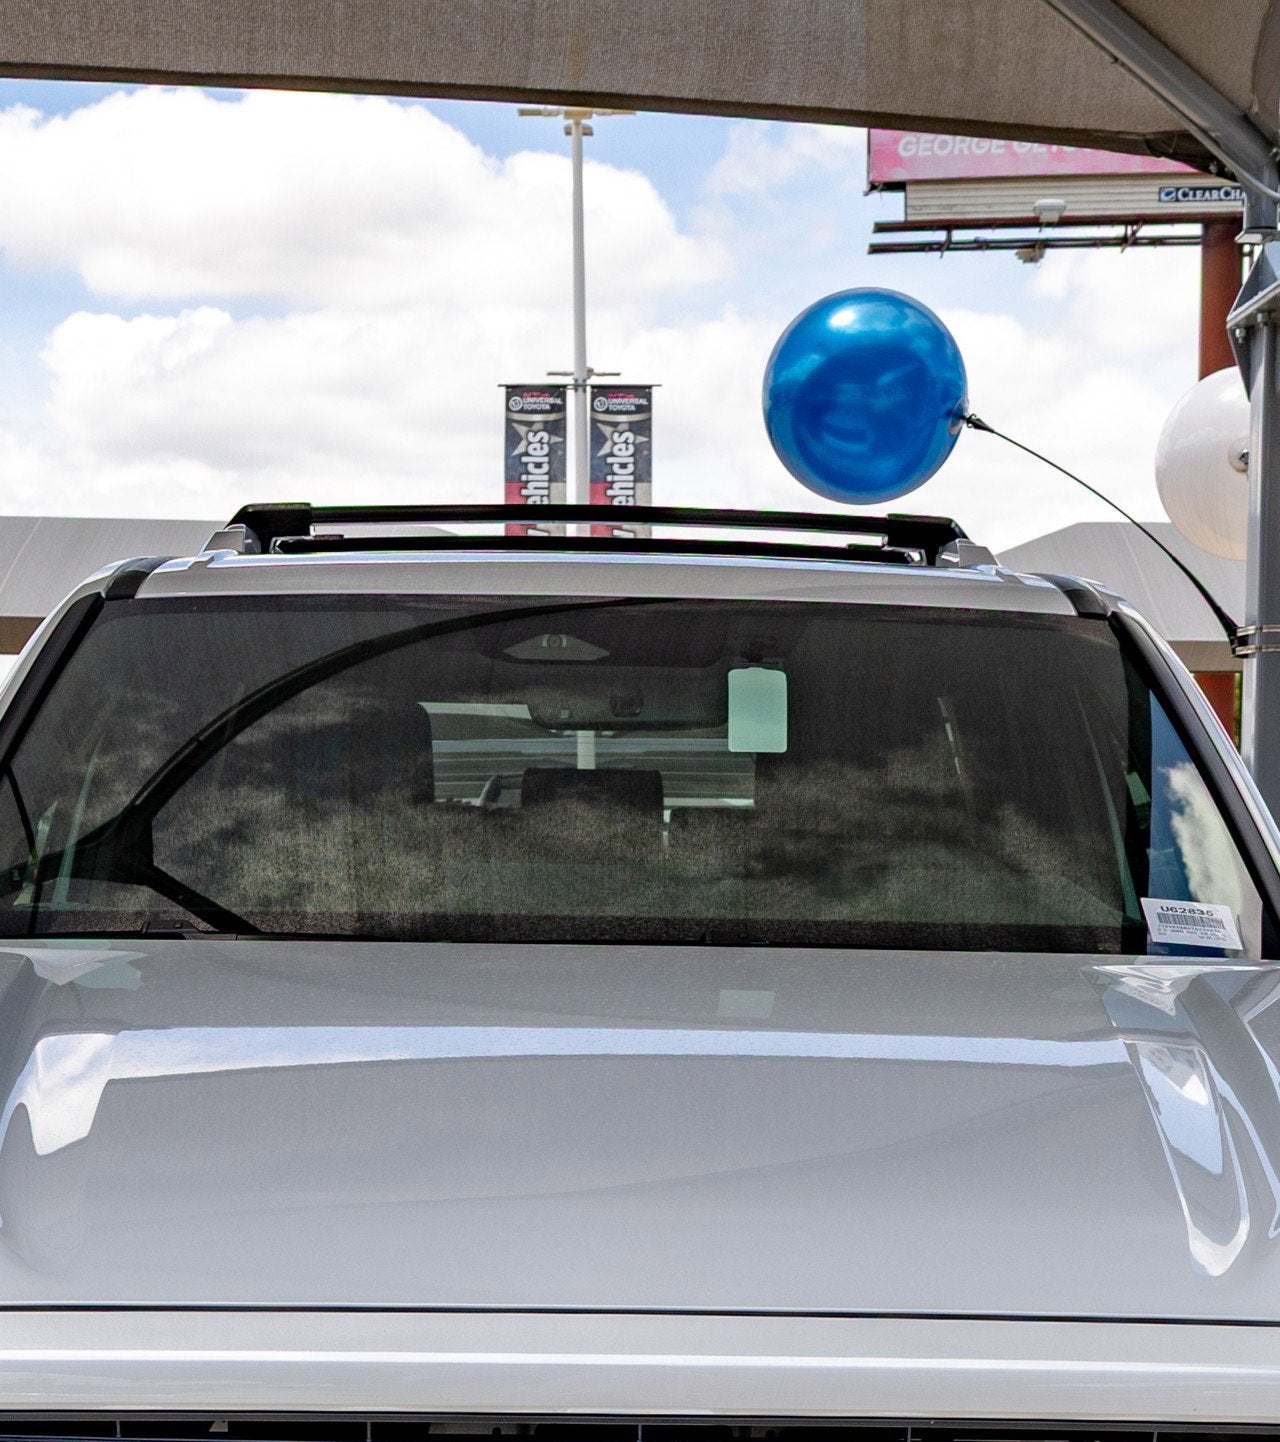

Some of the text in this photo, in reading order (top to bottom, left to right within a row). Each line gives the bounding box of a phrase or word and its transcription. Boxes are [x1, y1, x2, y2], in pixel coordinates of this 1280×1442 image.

[897, 134, 1010, 157] GEORGE
[521, 430, 549, 535] ehicles
[606, 431, 634, 537] ehicles
